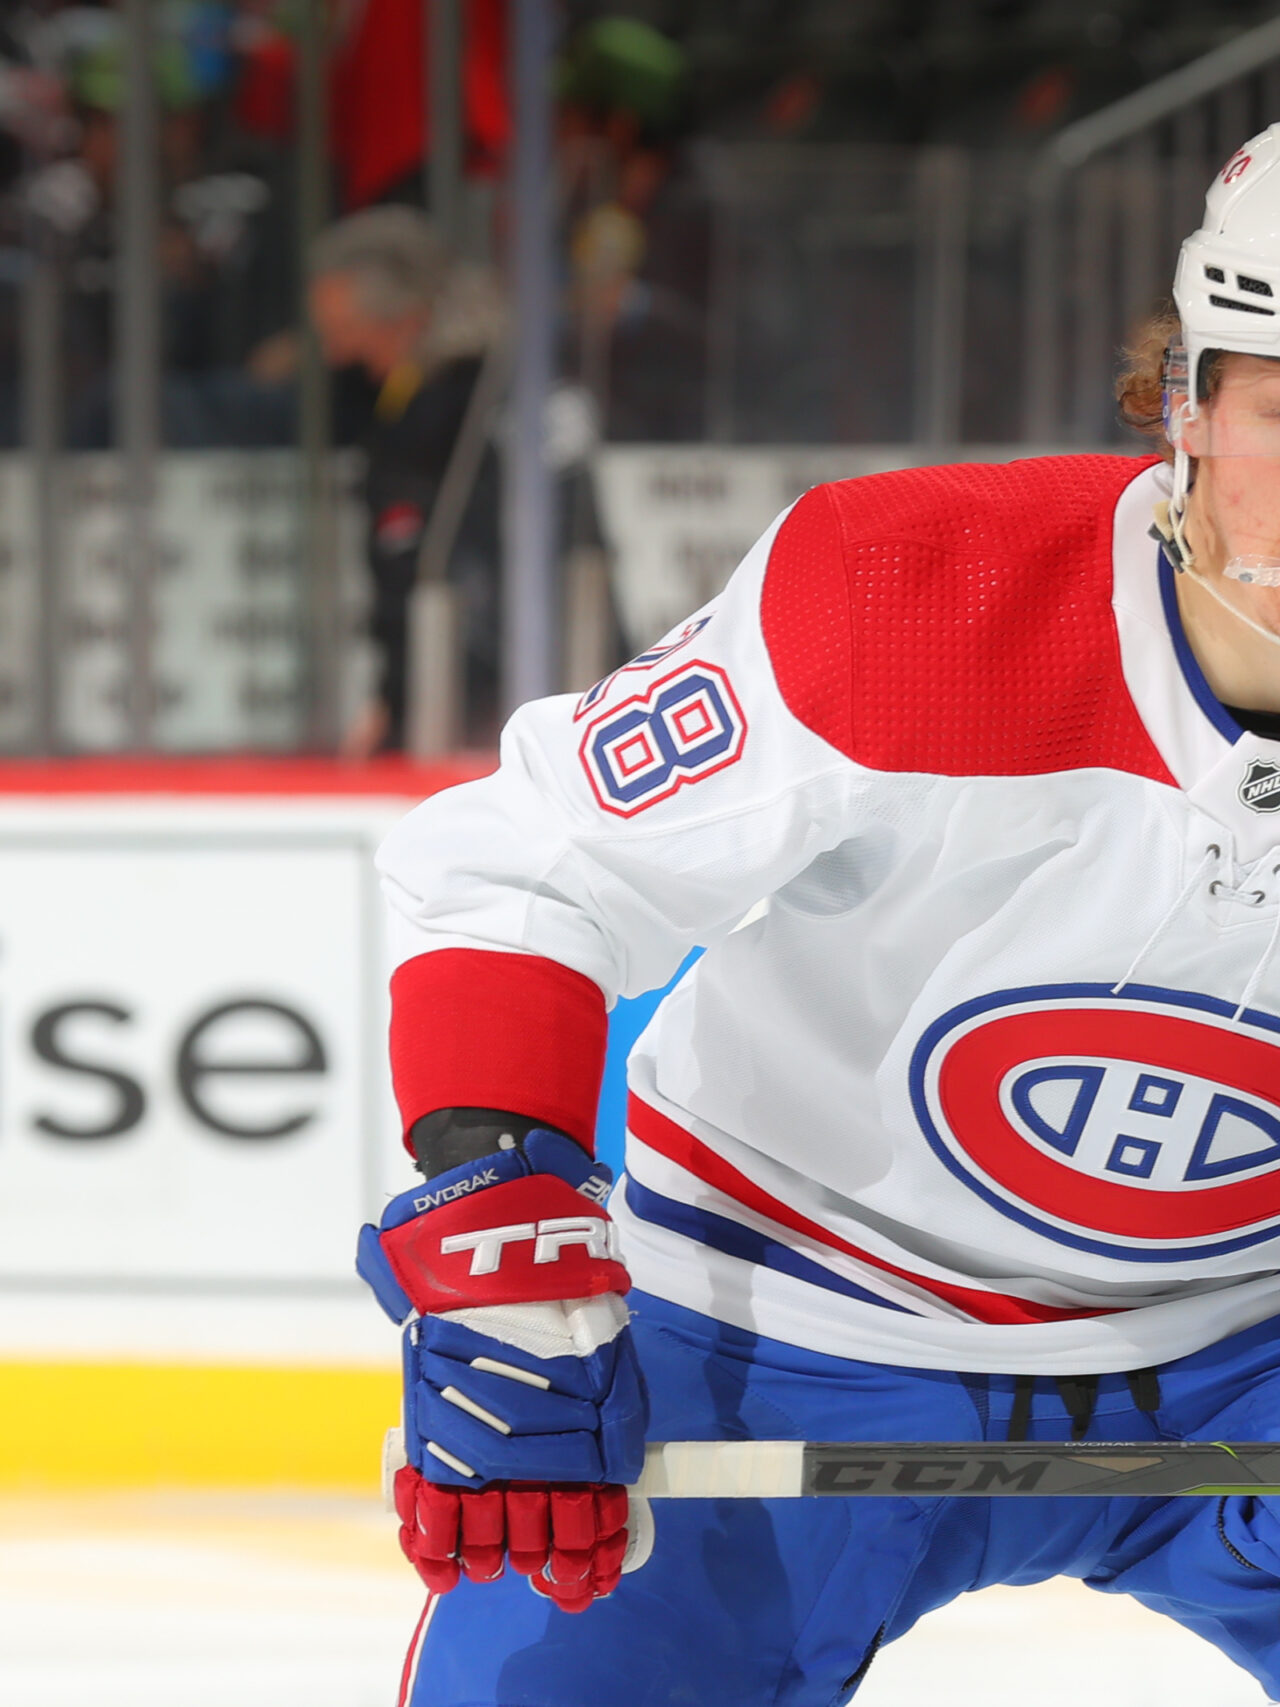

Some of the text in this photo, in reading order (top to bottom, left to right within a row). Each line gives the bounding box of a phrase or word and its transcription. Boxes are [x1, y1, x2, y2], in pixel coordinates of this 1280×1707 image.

[0, 990, 328, 1144] se
[413, 1168, 499, 1213] DVORAK
[813, 1459, 1052, 1492] CCM
